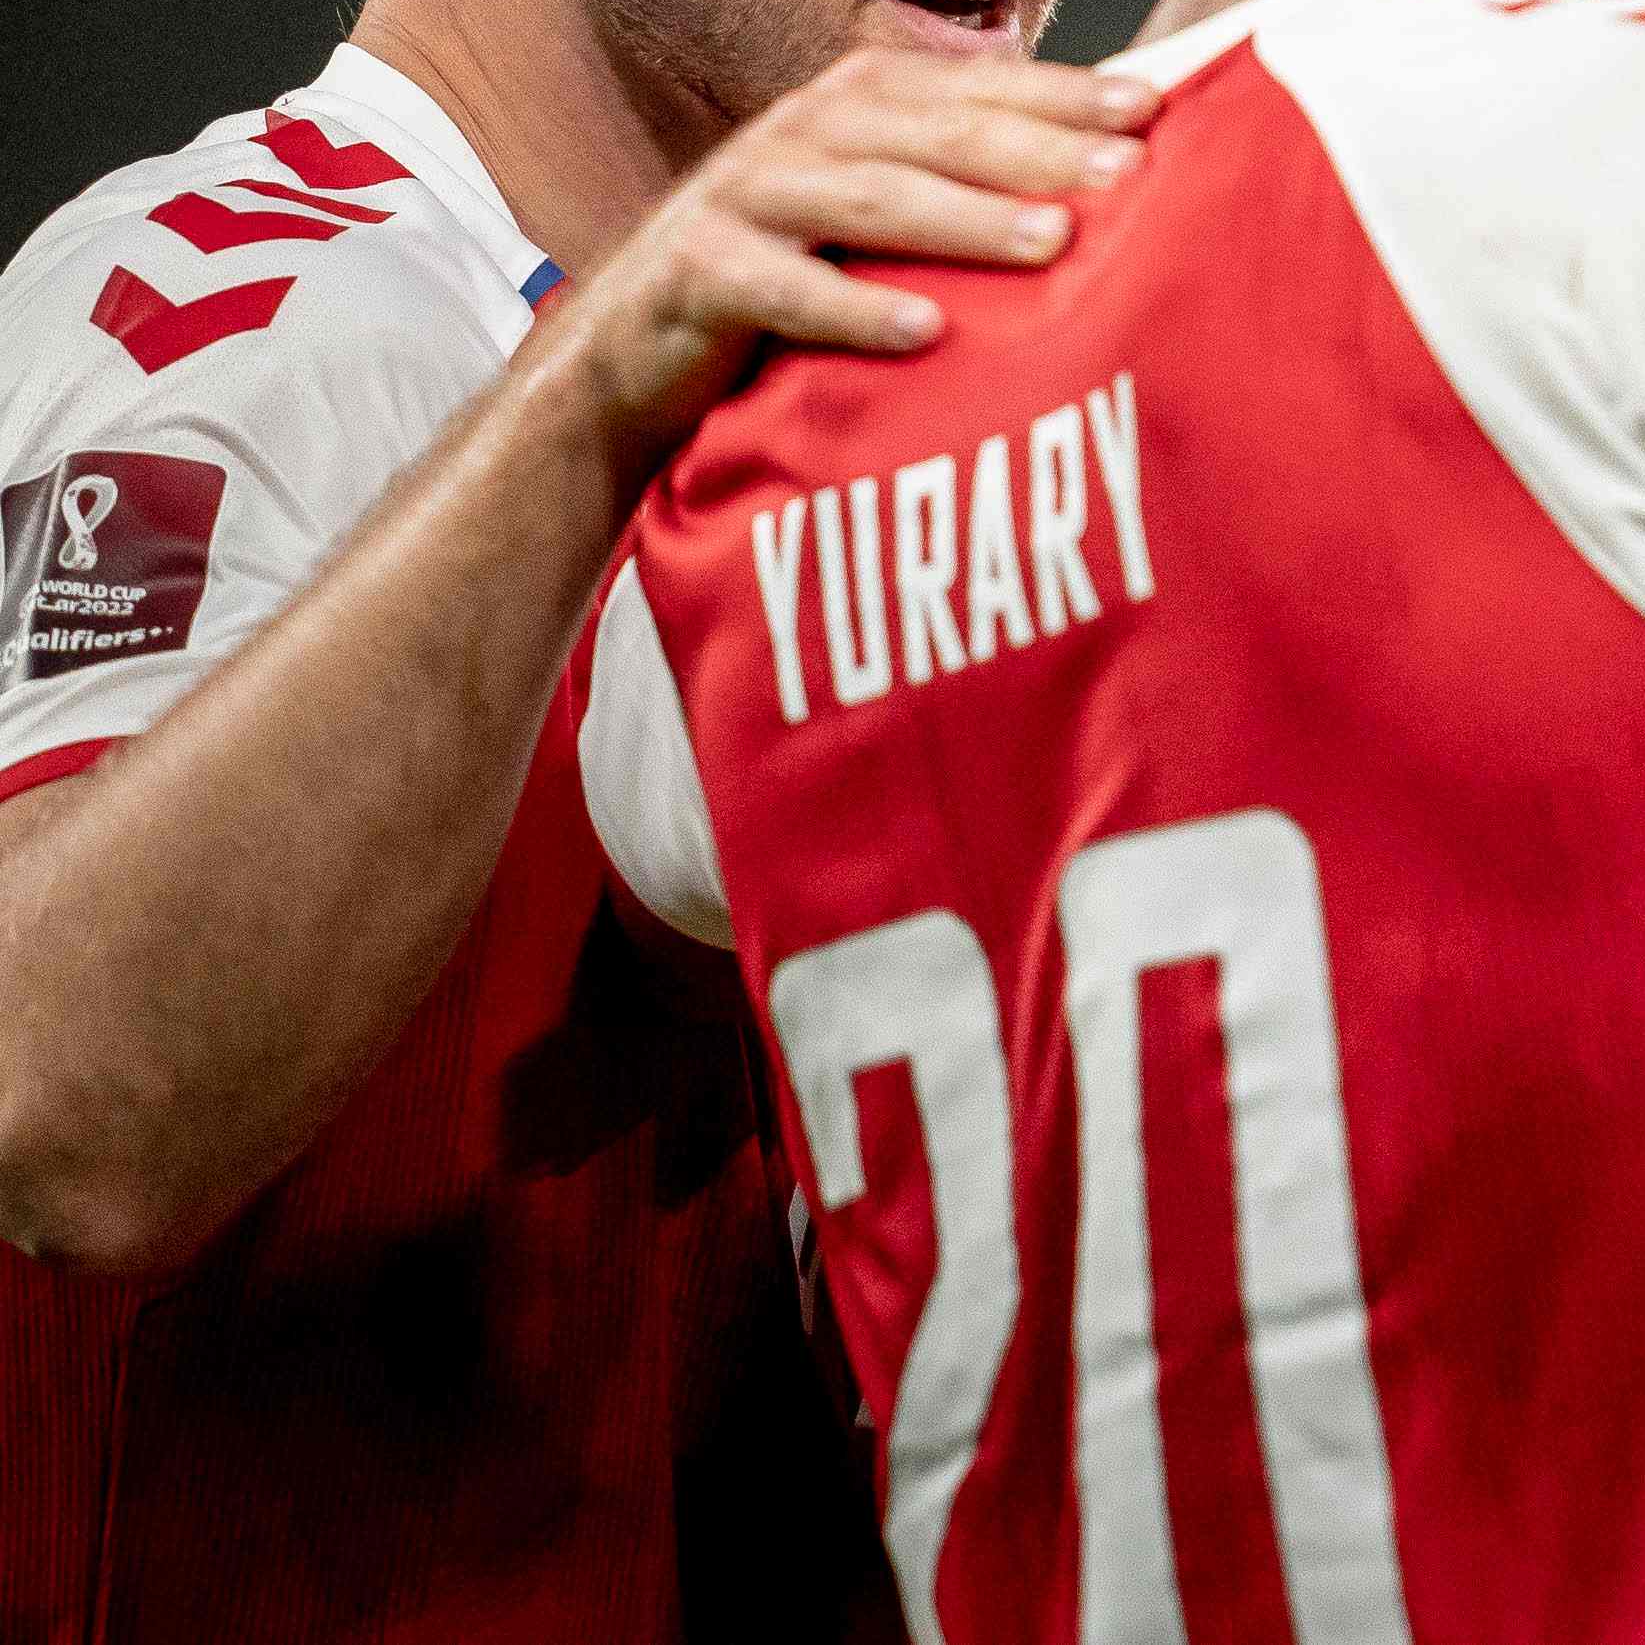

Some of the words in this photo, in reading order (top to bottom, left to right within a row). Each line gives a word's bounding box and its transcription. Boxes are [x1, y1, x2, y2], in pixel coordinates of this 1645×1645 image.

[41, 579, 108, 599] WORLD
[109, 585, 147, 601] CUP
[752, 371, 1156, 725] YURARY
[769, 806, 1414, 1645] 20
